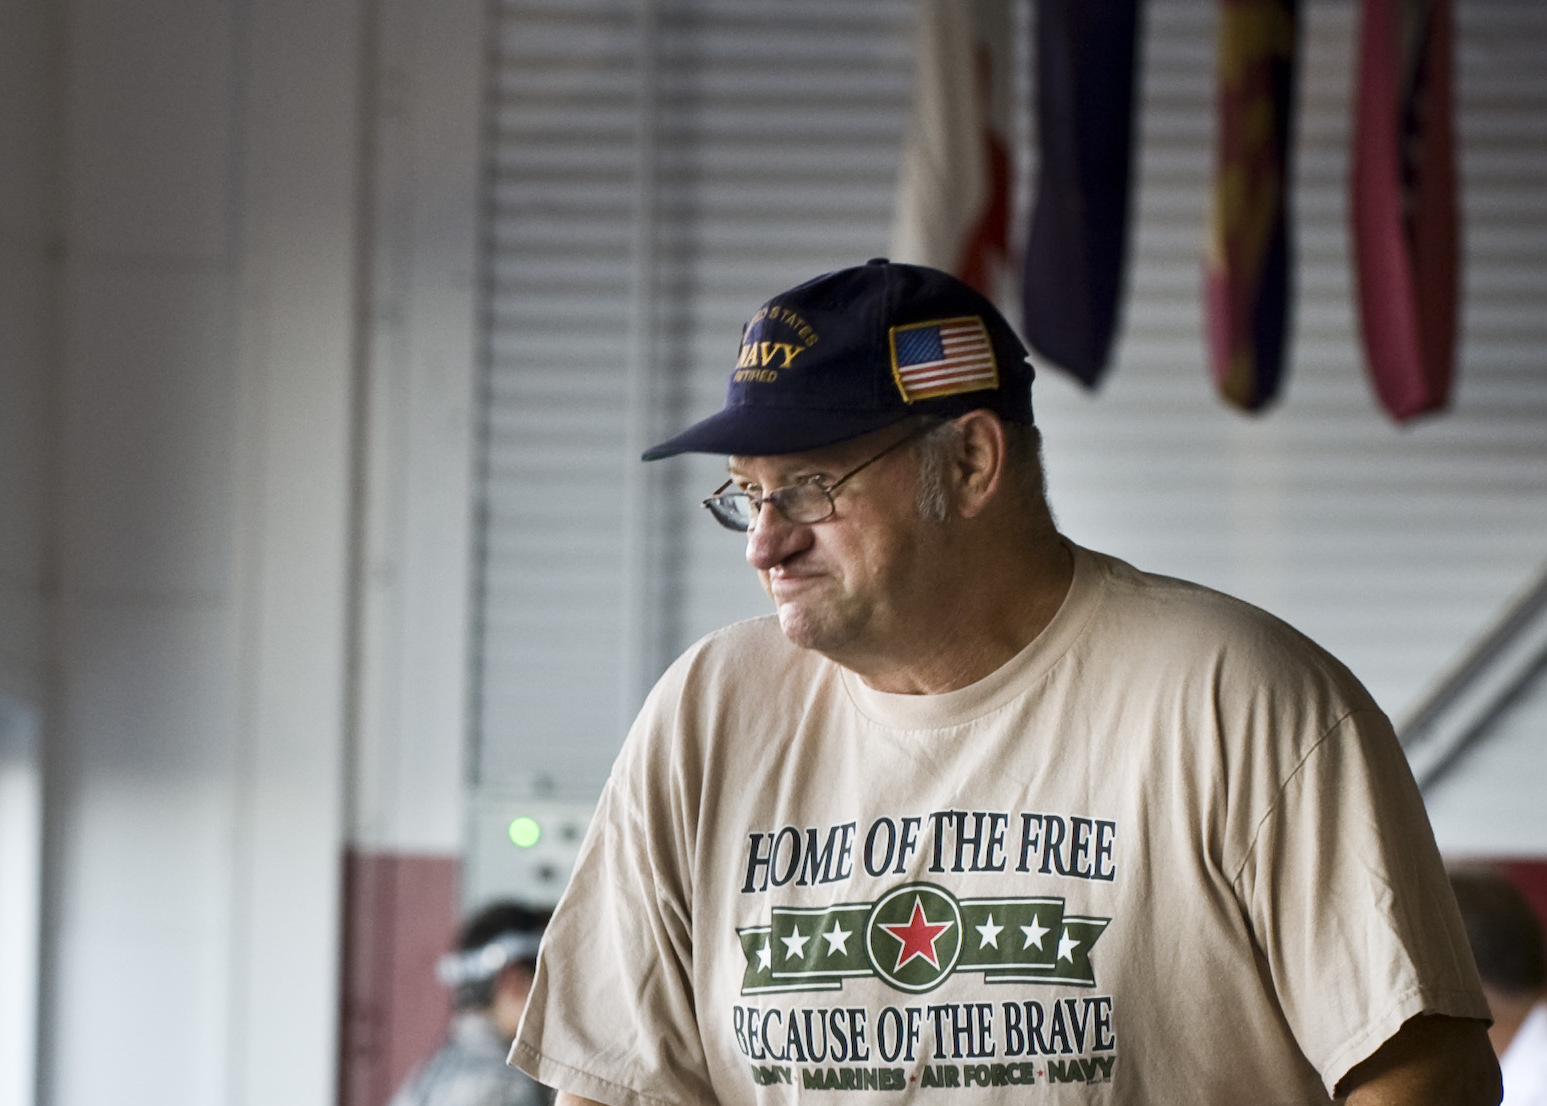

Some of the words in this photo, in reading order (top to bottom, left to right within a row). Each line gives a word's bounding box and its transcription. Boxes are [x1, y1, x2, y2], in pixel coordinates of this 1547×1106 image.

[735, 341, 805, 369] NAVY
[740, 821, 856, 894] HOME
[863, 816, 922, 877] OF
[927, 810, 1008, 874] THE
[1015, 812, 1116, 882] FREE
[733, 1004, 870, 1063] BECAUSE
[877, 1006, 922, 1062] OF
[926, 1001, 996, 1061] THE
[1004, 997, 1115, 1056] BRAVE
[751, 1064, 793, 1086] RMY
[802, 1066, 906, 1091] MARINES
[920, 1064, 963, 1089] AIR
[964, 1061, 1034, 1087] FORCE
[1048, 1056, 1116, 1084] NAVY
